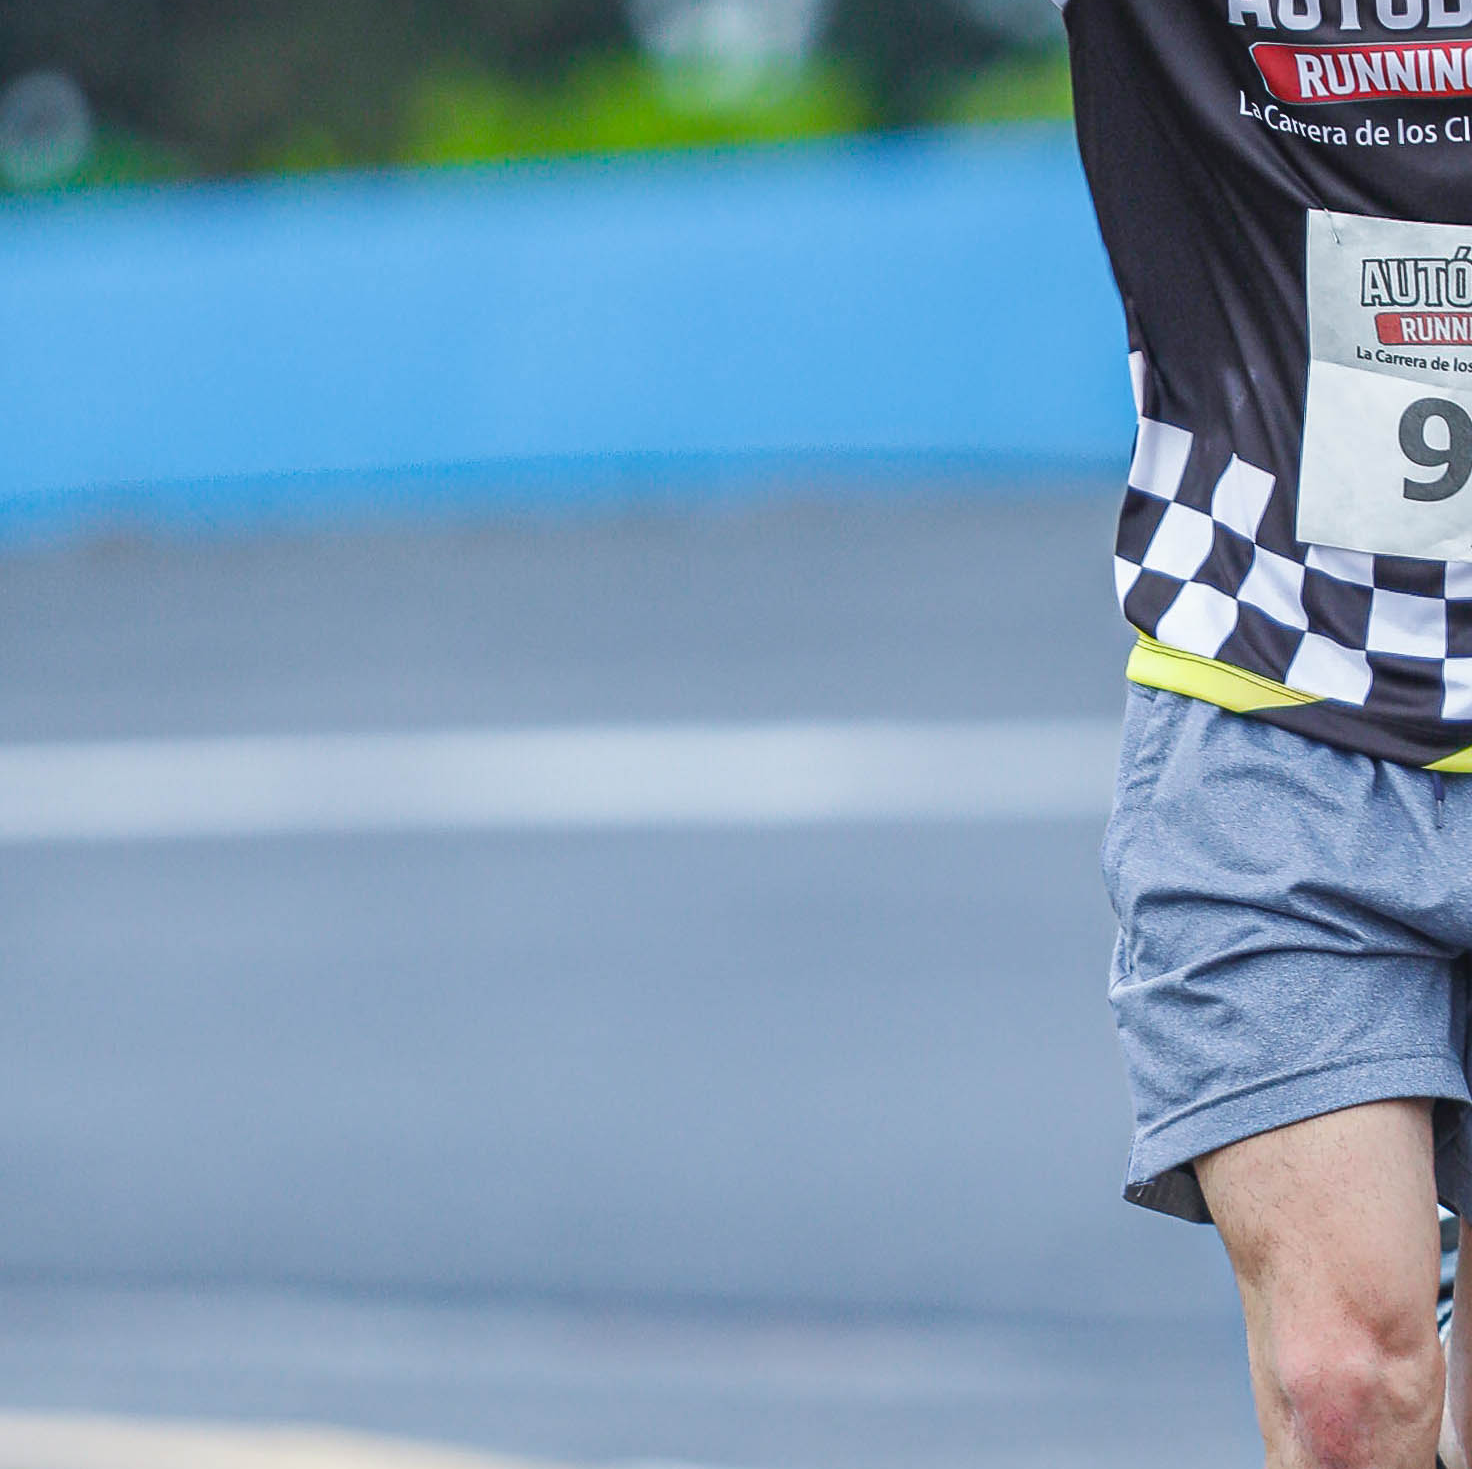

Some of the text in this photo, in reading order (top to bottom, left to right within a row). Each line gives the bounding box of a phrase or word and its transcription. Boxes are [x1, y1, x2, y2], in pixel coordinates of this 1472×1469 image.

[1239, 89, 1263, 121] La
[1264, 104, 1348, 146] Carrera
[1355, 119, 1390, 146] de
[1397, 117, 1438, 145] los
[1356, 345, 1373, 361] La
[1375, 348, 1428, 370] Carrera
[1431, 356, 1450, 372] de
